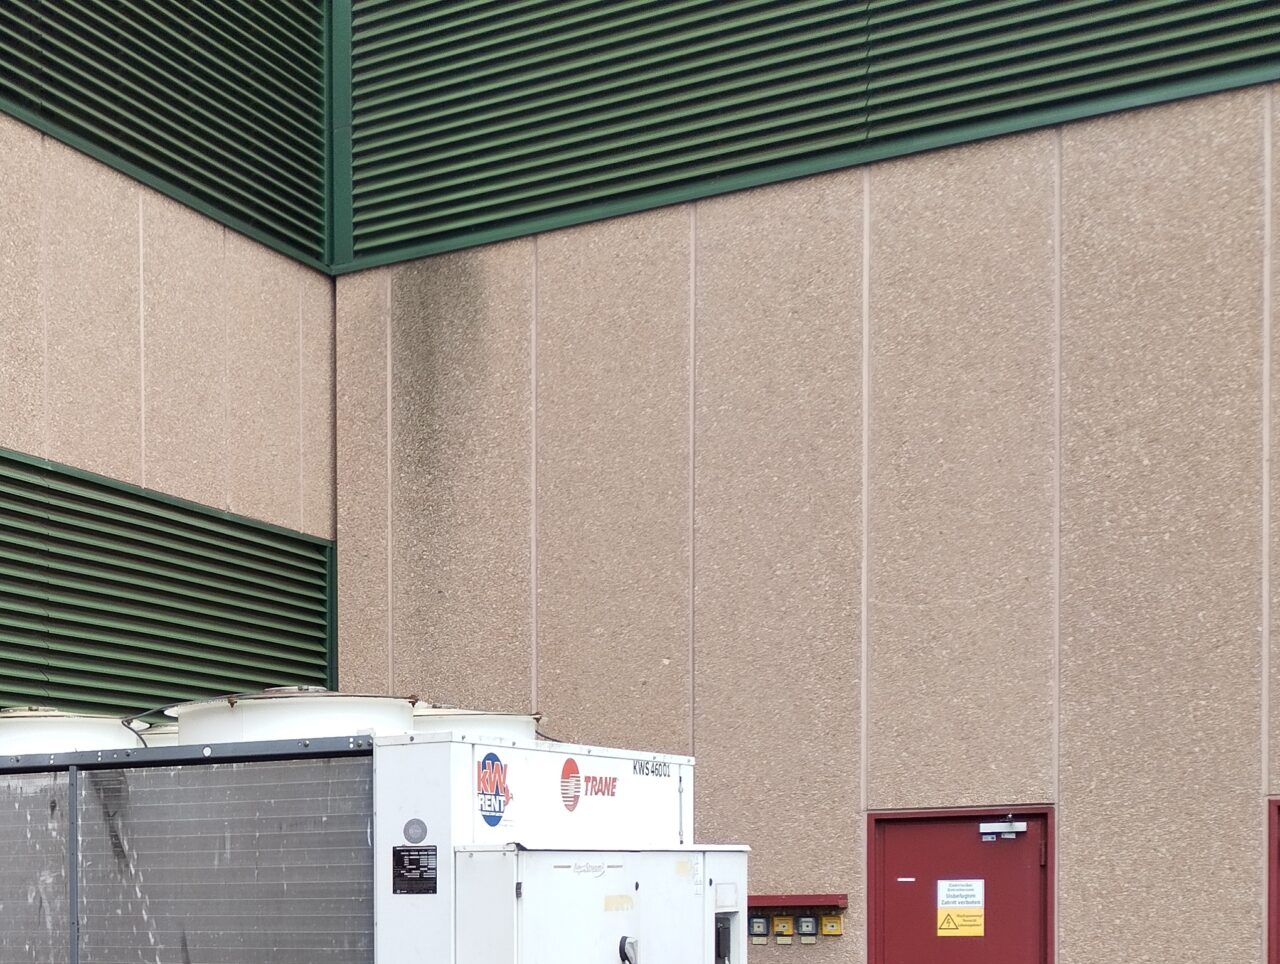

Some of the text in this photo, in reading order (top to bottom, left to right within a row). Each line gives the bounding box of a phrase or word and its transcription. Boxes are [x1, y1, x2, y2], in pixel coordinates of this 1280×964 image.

[633, 760, 671, 778] KWS 46001
[584, 775, 618, 797] TRANE
[478, 793, 505, 813] RENT
